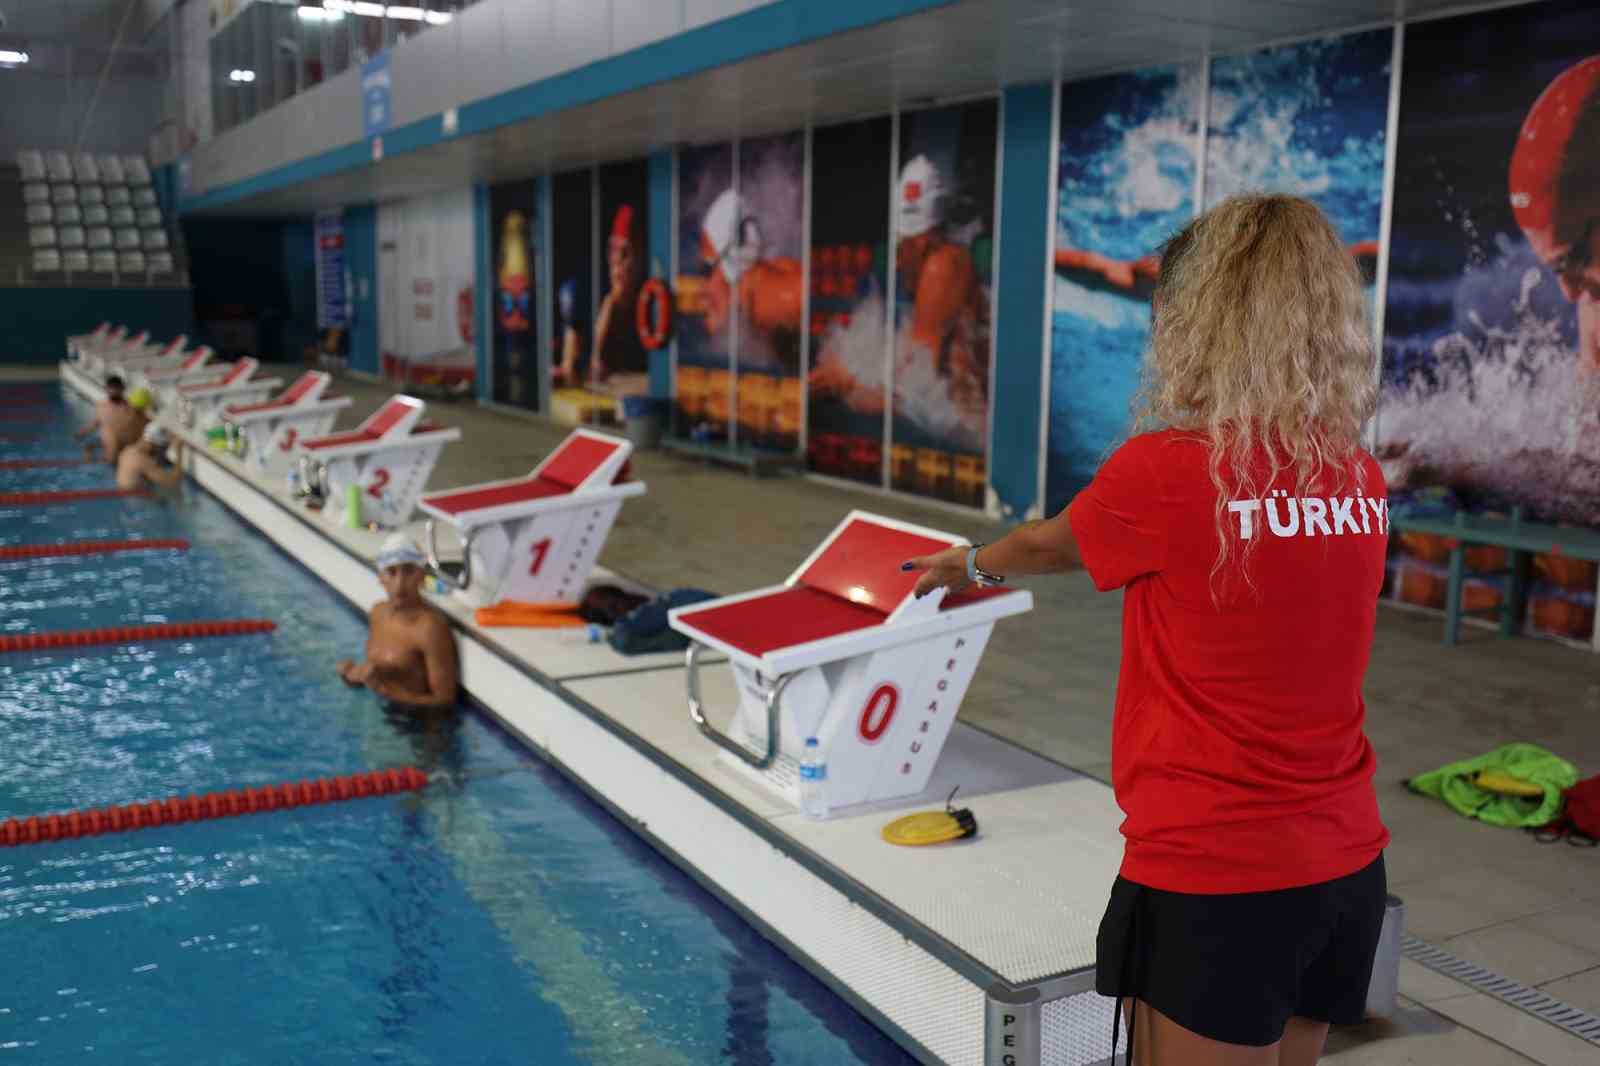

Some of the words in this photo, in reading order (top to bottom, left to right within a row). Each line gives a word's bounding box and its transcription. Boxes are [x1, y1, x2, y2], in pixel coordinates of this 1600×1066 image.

[364, 466, 391, 500] 2
[1227, 487, 1390, 540] TÜRKİY
[527, 536, 552, 577] 1
[858, 684, 898, 741] 0
